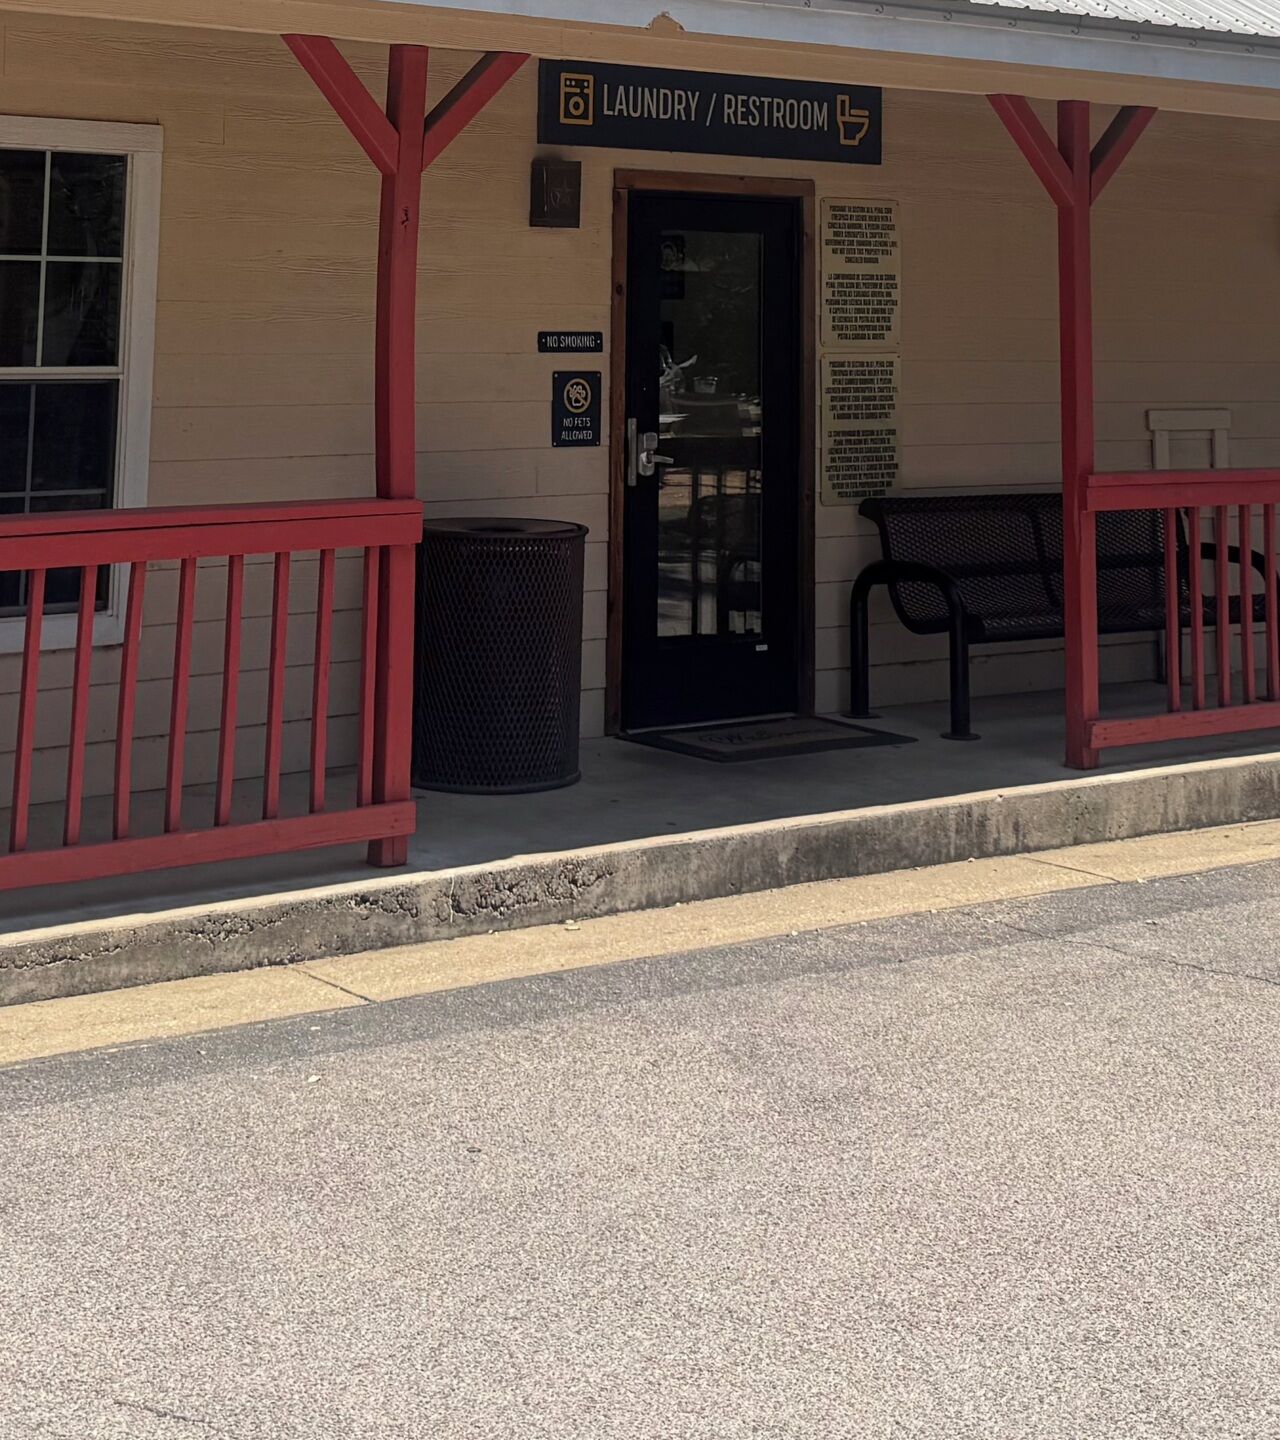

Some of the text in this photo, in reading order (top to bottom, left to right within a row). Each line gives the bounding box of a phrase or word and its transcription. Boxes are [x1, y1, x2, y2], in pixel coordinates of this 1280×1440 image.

[603, 83, 829, 132] LAUNDRY / RESTROOM
[546, 335, 595, 348] NO SMOKING
[563, 417, 591, 427] NO PETS
[561, 430, 593, 441] ALLOWED
